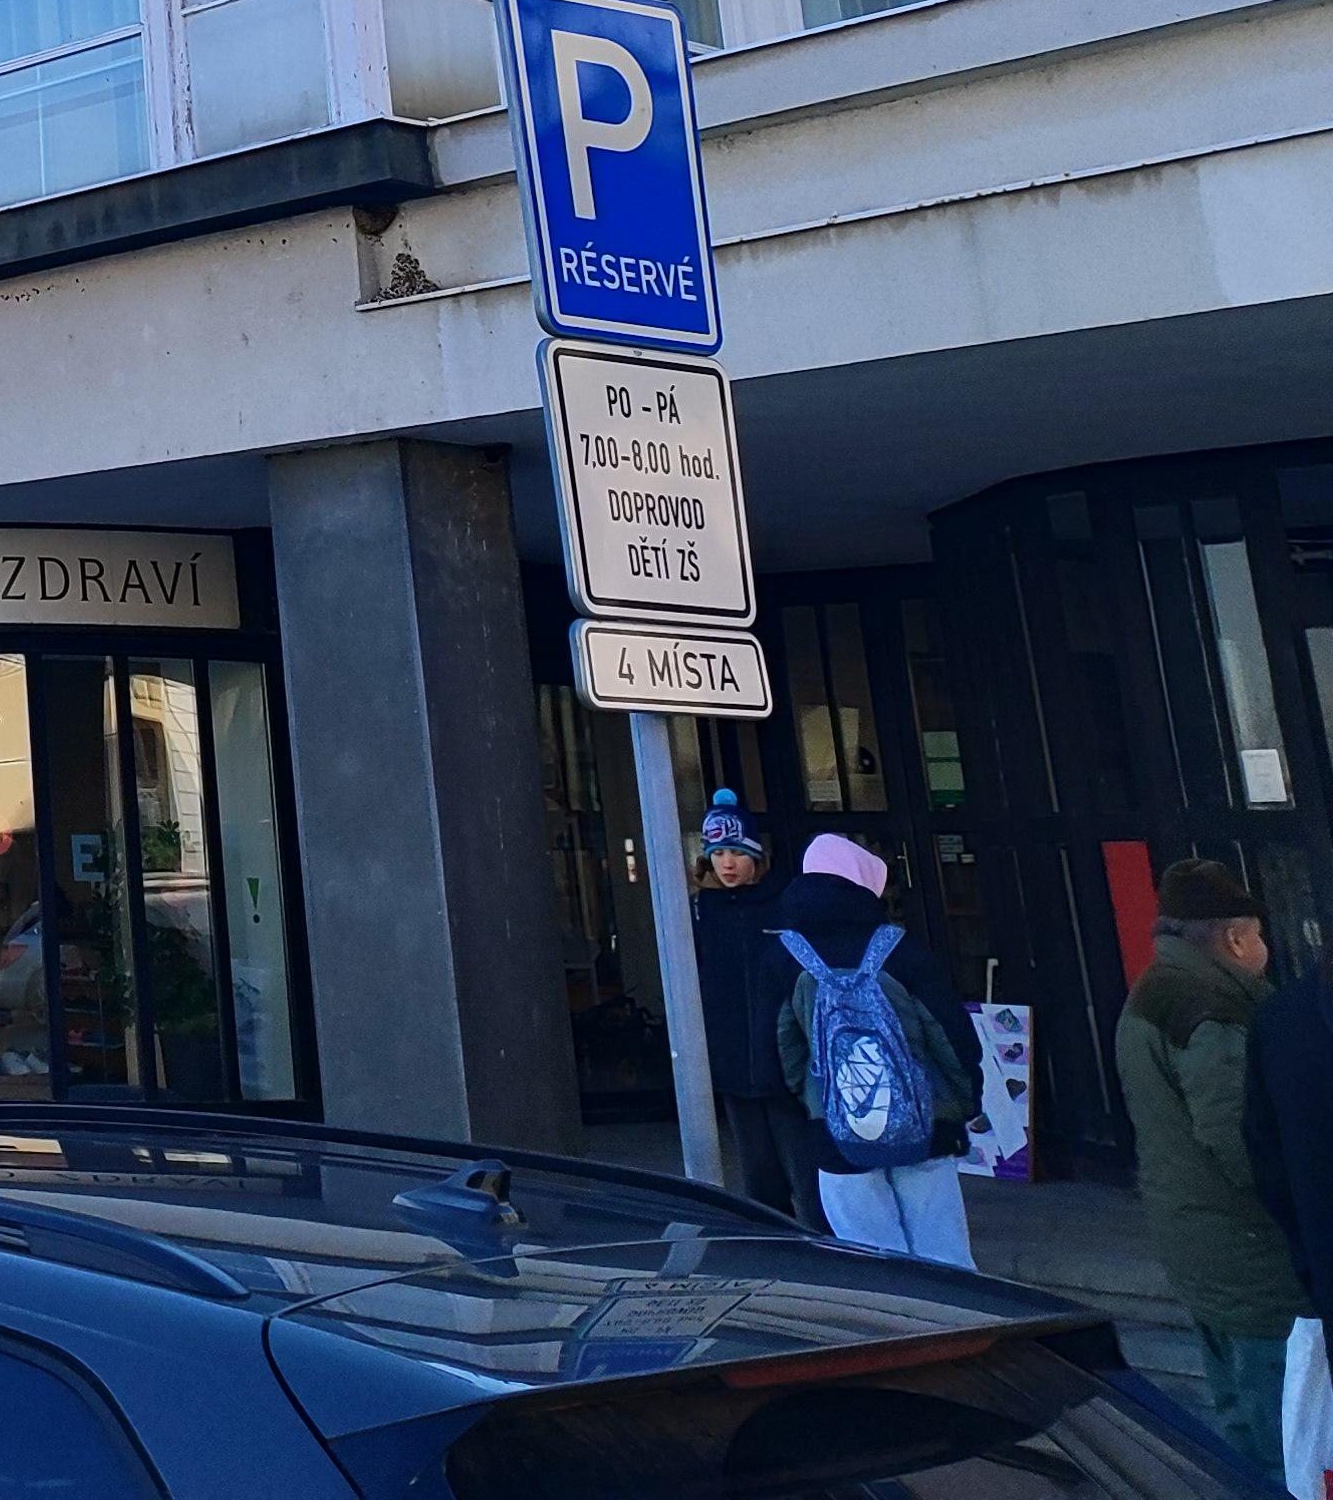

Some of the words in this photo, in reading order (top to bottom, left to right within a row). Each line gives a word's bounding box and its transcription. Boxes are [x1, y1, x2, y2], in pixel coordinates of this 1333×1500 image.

[550, 28, 654, 221] P
[559, 241, 698, 303] RÉSERVÉ
[605, 384, 632, 418] PO
[655, 385, 682, 425] PÁ
[579, 433, 671, 476] 7,00-8,00
[678, 444, 721, 482] hod.
[607, 488, 706, 531] DOPROVOD
[0, 552, 204, 607] ZDRAVÍ
[627, 535, 670, 581] DĚTÍ
[678, 540, 702, 583] ZŠ
[617, 647, 635, 686] 4
[647, 642, 741, 693] MÍSTA
